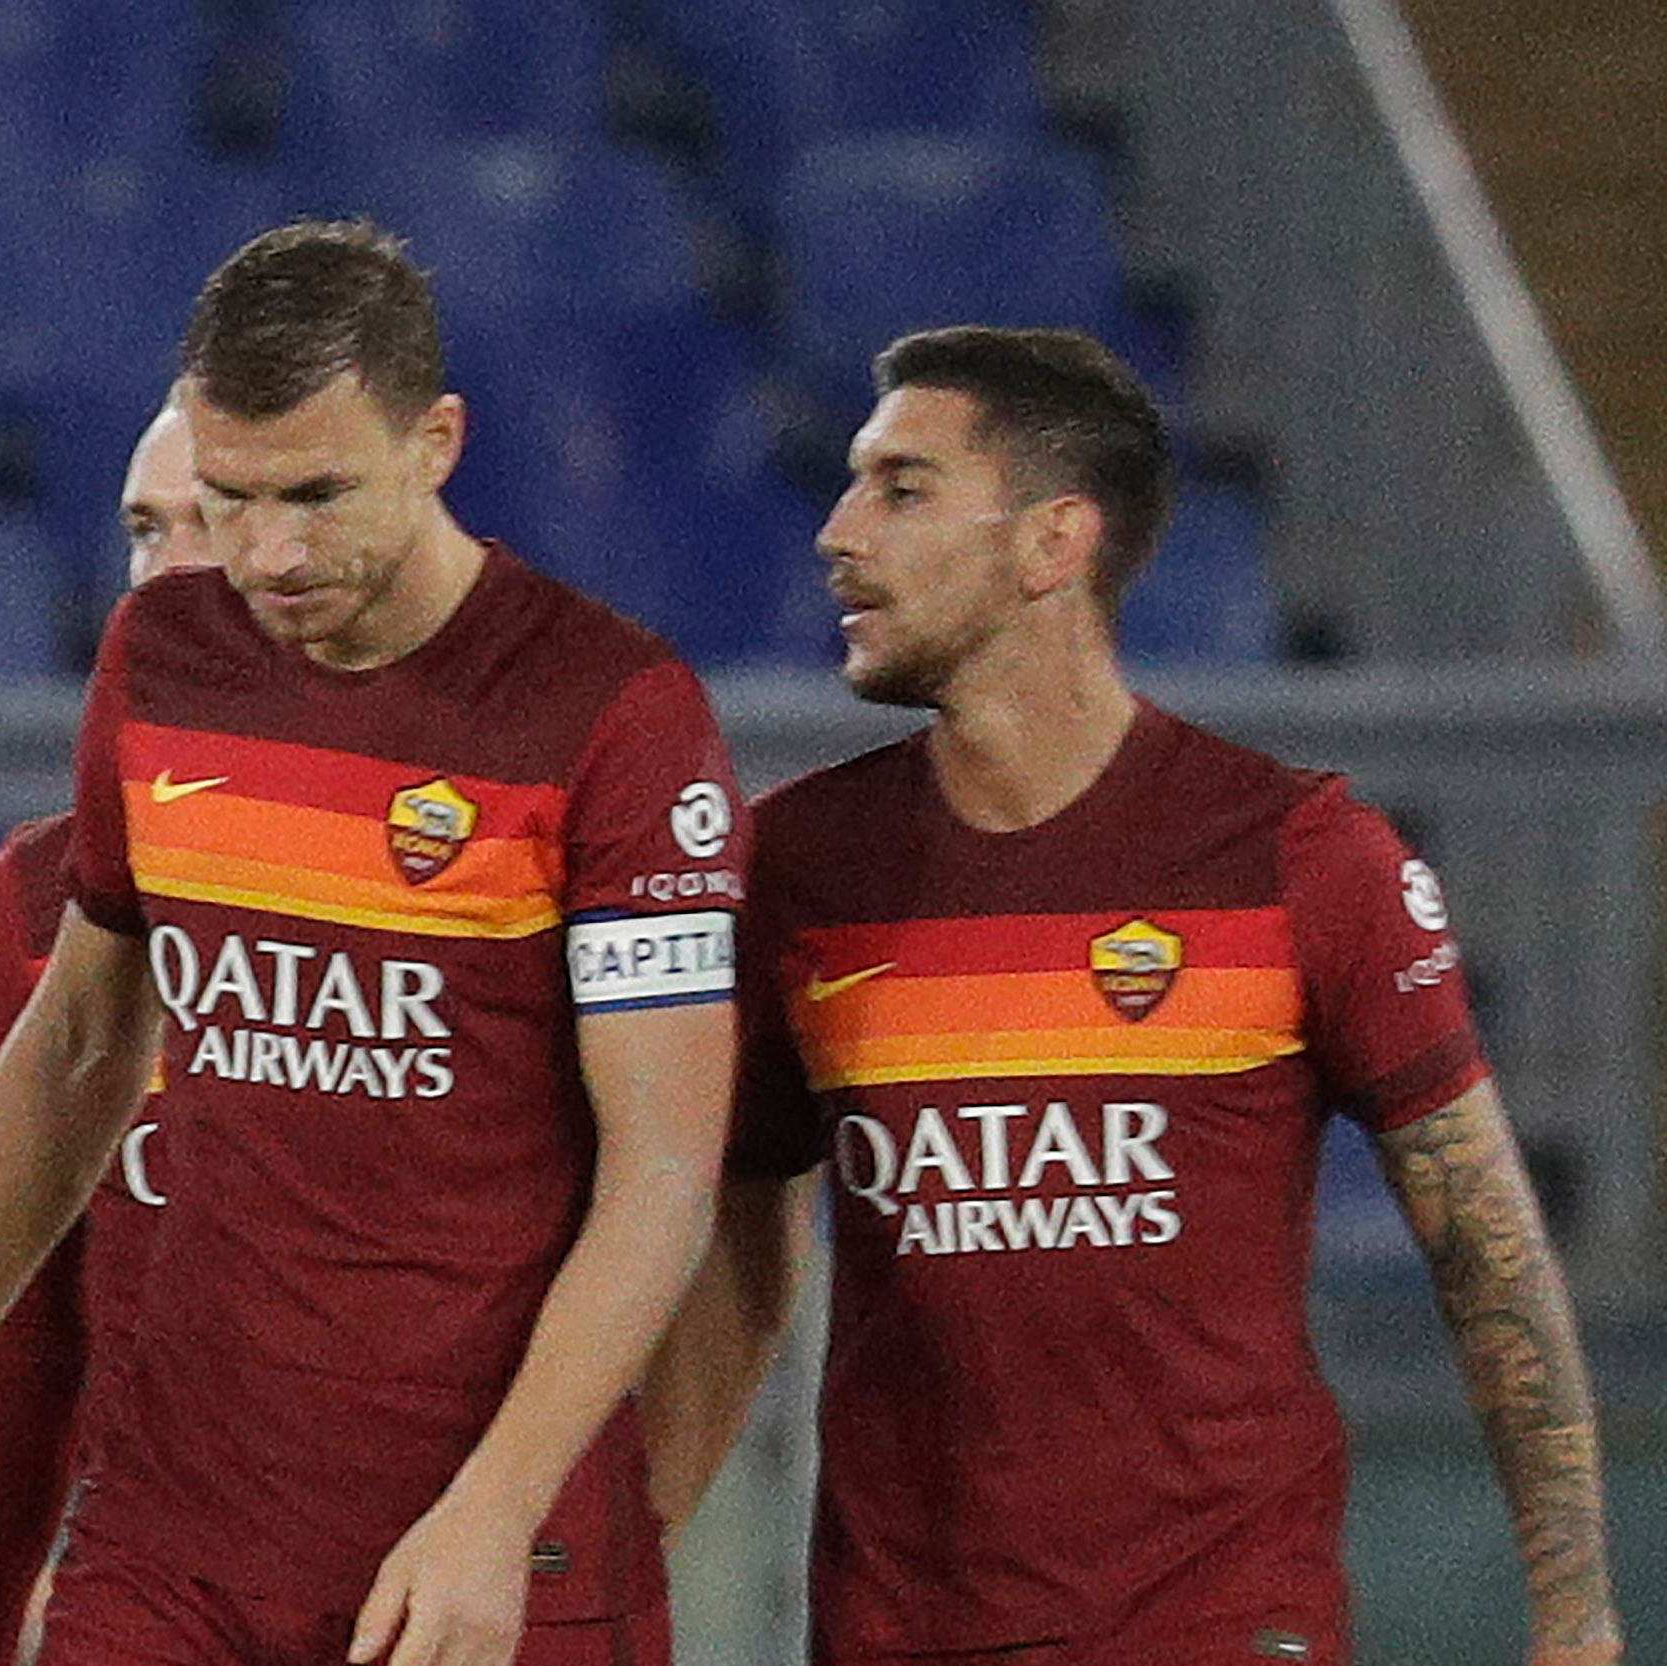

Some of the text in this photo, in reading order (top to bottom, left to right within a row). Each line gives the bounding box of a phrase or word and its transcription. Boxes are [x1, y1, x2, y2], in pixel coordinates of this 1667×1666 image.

[149, 924, 452, 1039] QATAR
[188, 1028, 454, 1099] AIRWAYS
[836, 1101, 1175, 1215] QATAR
[896, 1190, 1183, 1258] AIRWAYS
